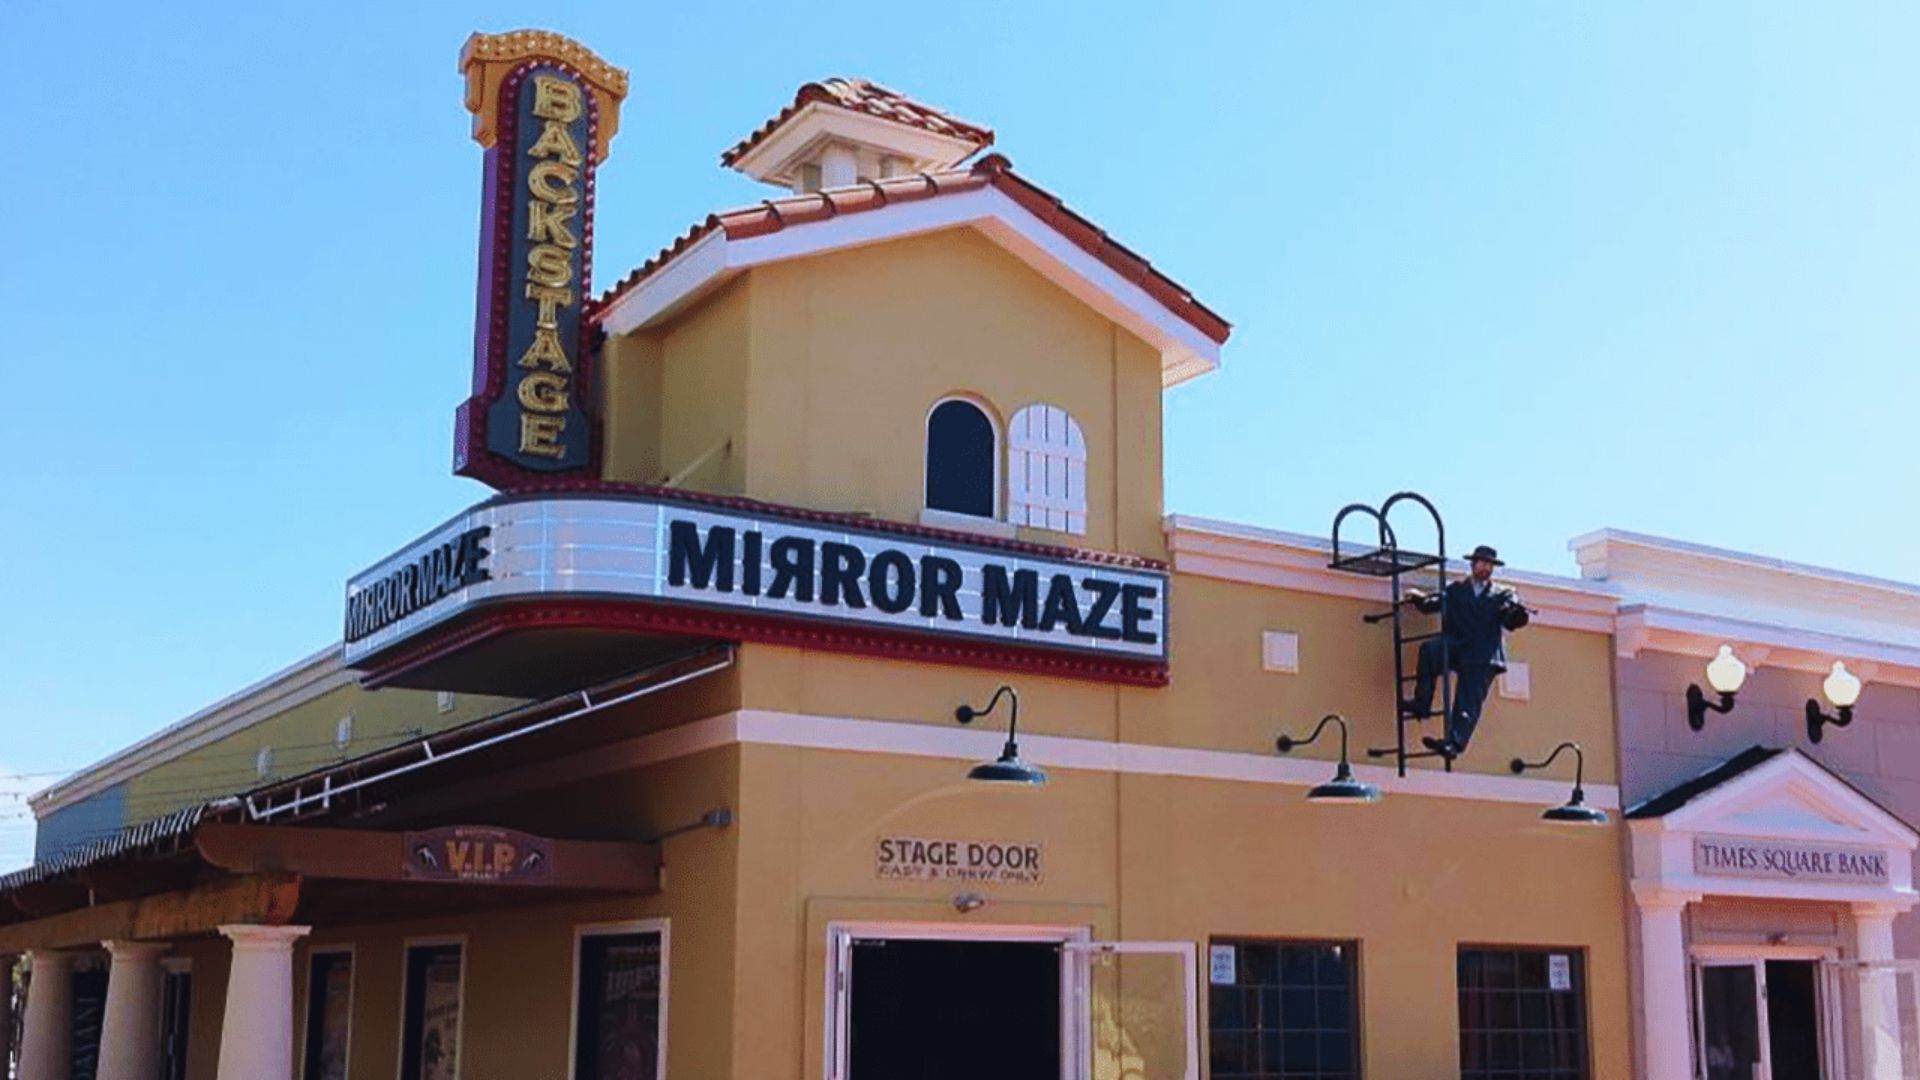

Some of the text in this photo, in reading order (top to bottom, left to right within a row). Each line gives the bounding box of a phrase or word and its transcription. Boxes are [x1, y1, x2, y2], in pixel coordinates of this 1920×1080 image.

[518, 75, 583, 460] BACKSTAGE
[416, 525, 493, 608] MAZE
[981, 563, 1158, 645] MAZE
[879, 839, 1039, 871] STAGE DOOR
[1701, 844, 1886, 876] TIMES SQUARE BANK
